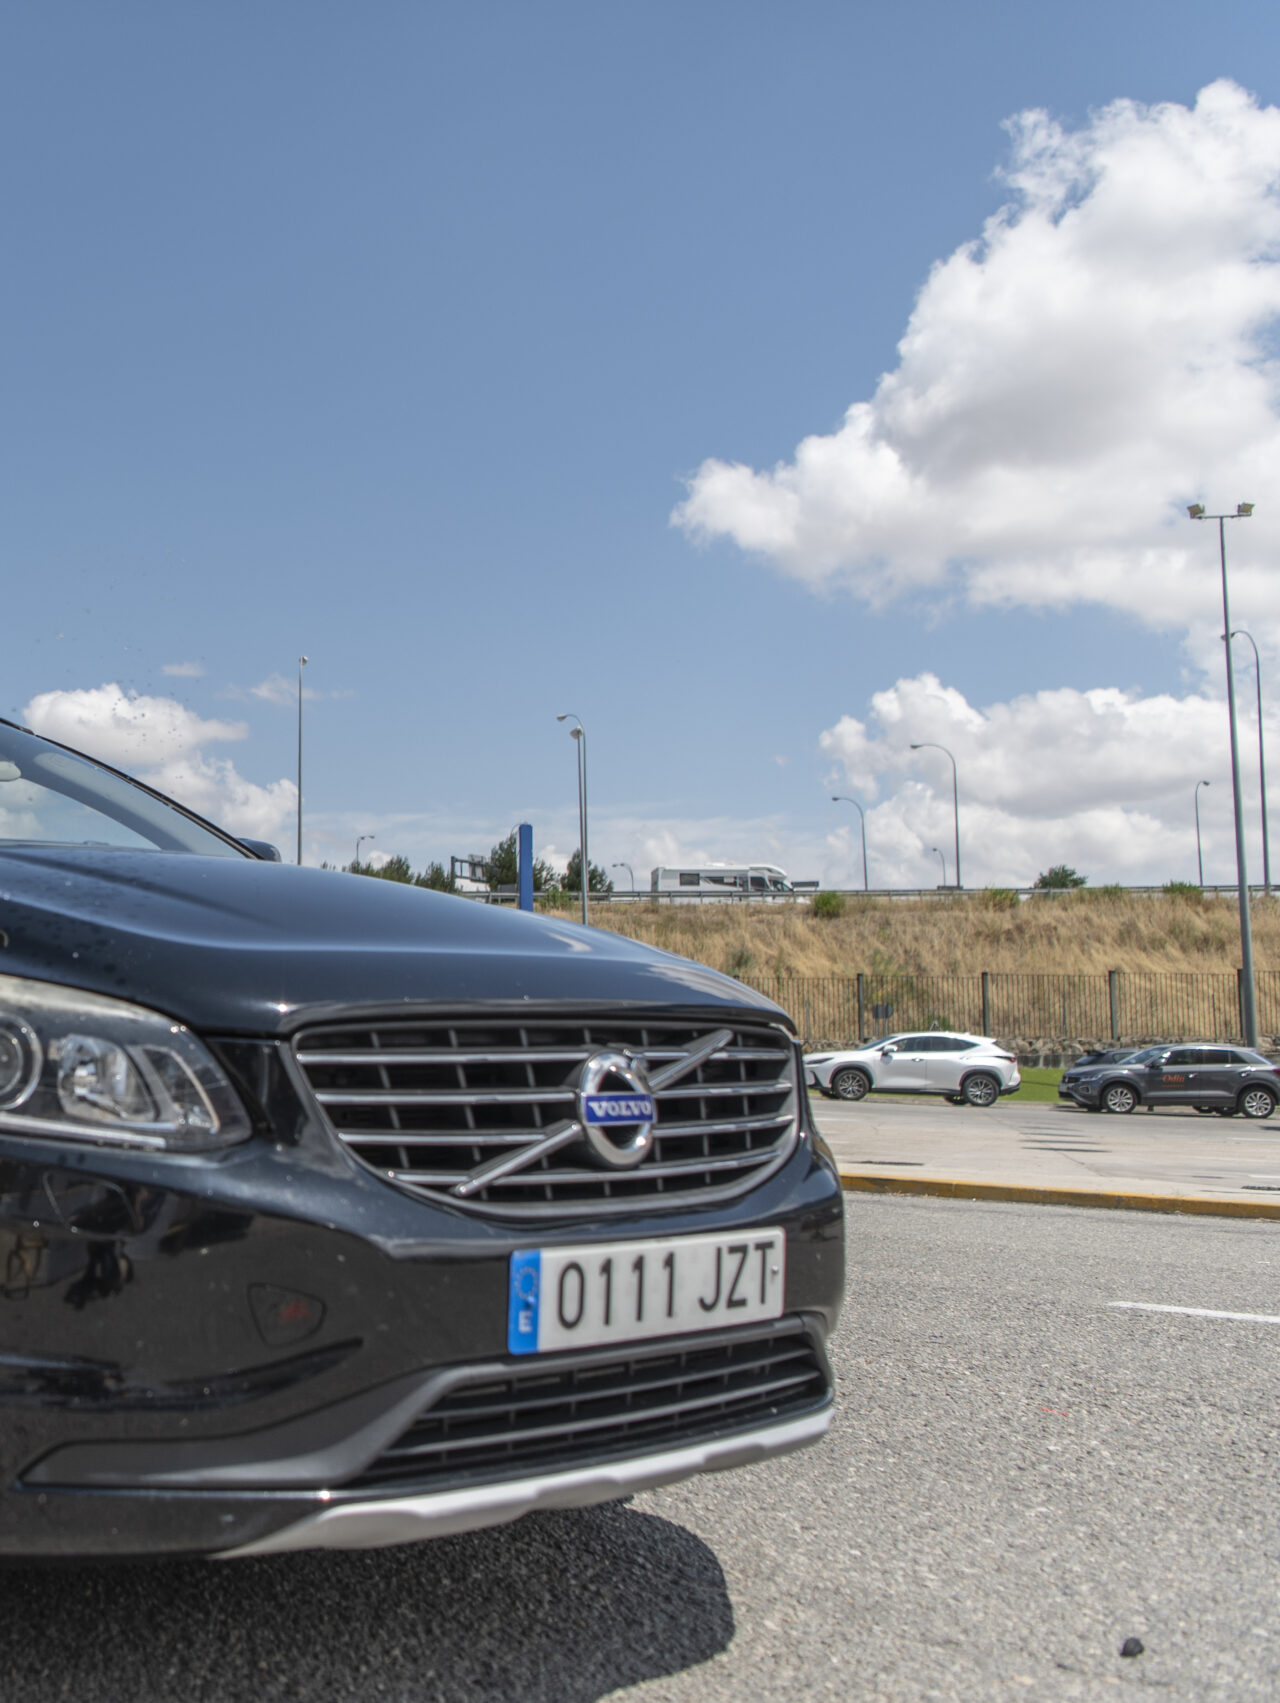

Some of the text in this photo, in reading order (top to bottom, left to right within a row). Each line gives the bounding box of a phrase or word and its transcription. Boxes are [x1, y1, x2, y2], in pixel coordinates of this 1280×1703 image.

[587, 1100, 652, 1118] VOLVO
[557, 1241, 775, 1330] 0111 JZT
